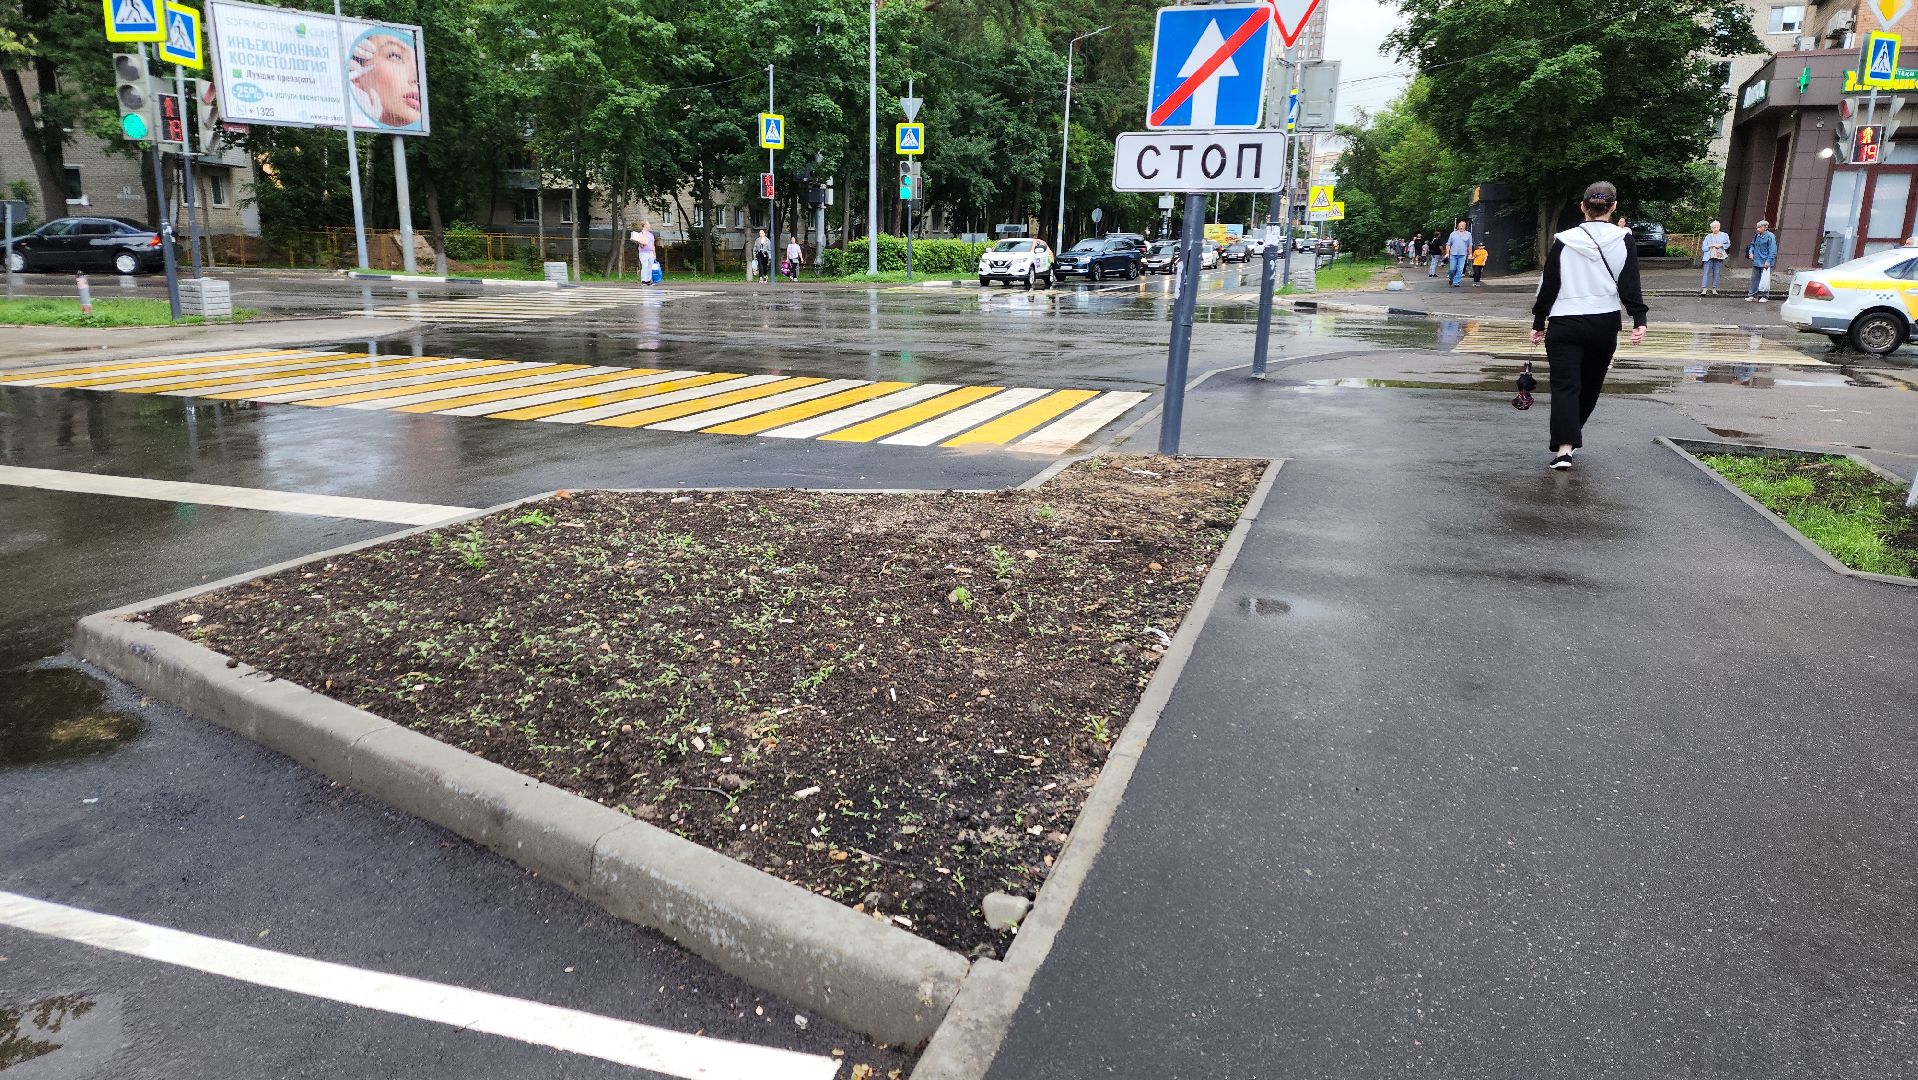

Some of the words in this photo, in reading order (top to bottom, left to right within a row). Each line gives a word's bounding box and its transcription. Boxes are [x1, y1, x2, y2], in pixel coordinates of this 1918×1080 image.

[227, 35, 330, 59] ИНЪЕКЦИОННАЯ
[229, 51, 327, 73] КОСМЕТОЛОГИЯ
[246, 70, 275, 81] Лучшие
[278, 75, 316, 85] препараты
[1137, 143, 1263, 179] СТОП
[1863, 144, 1877, 162] 19
